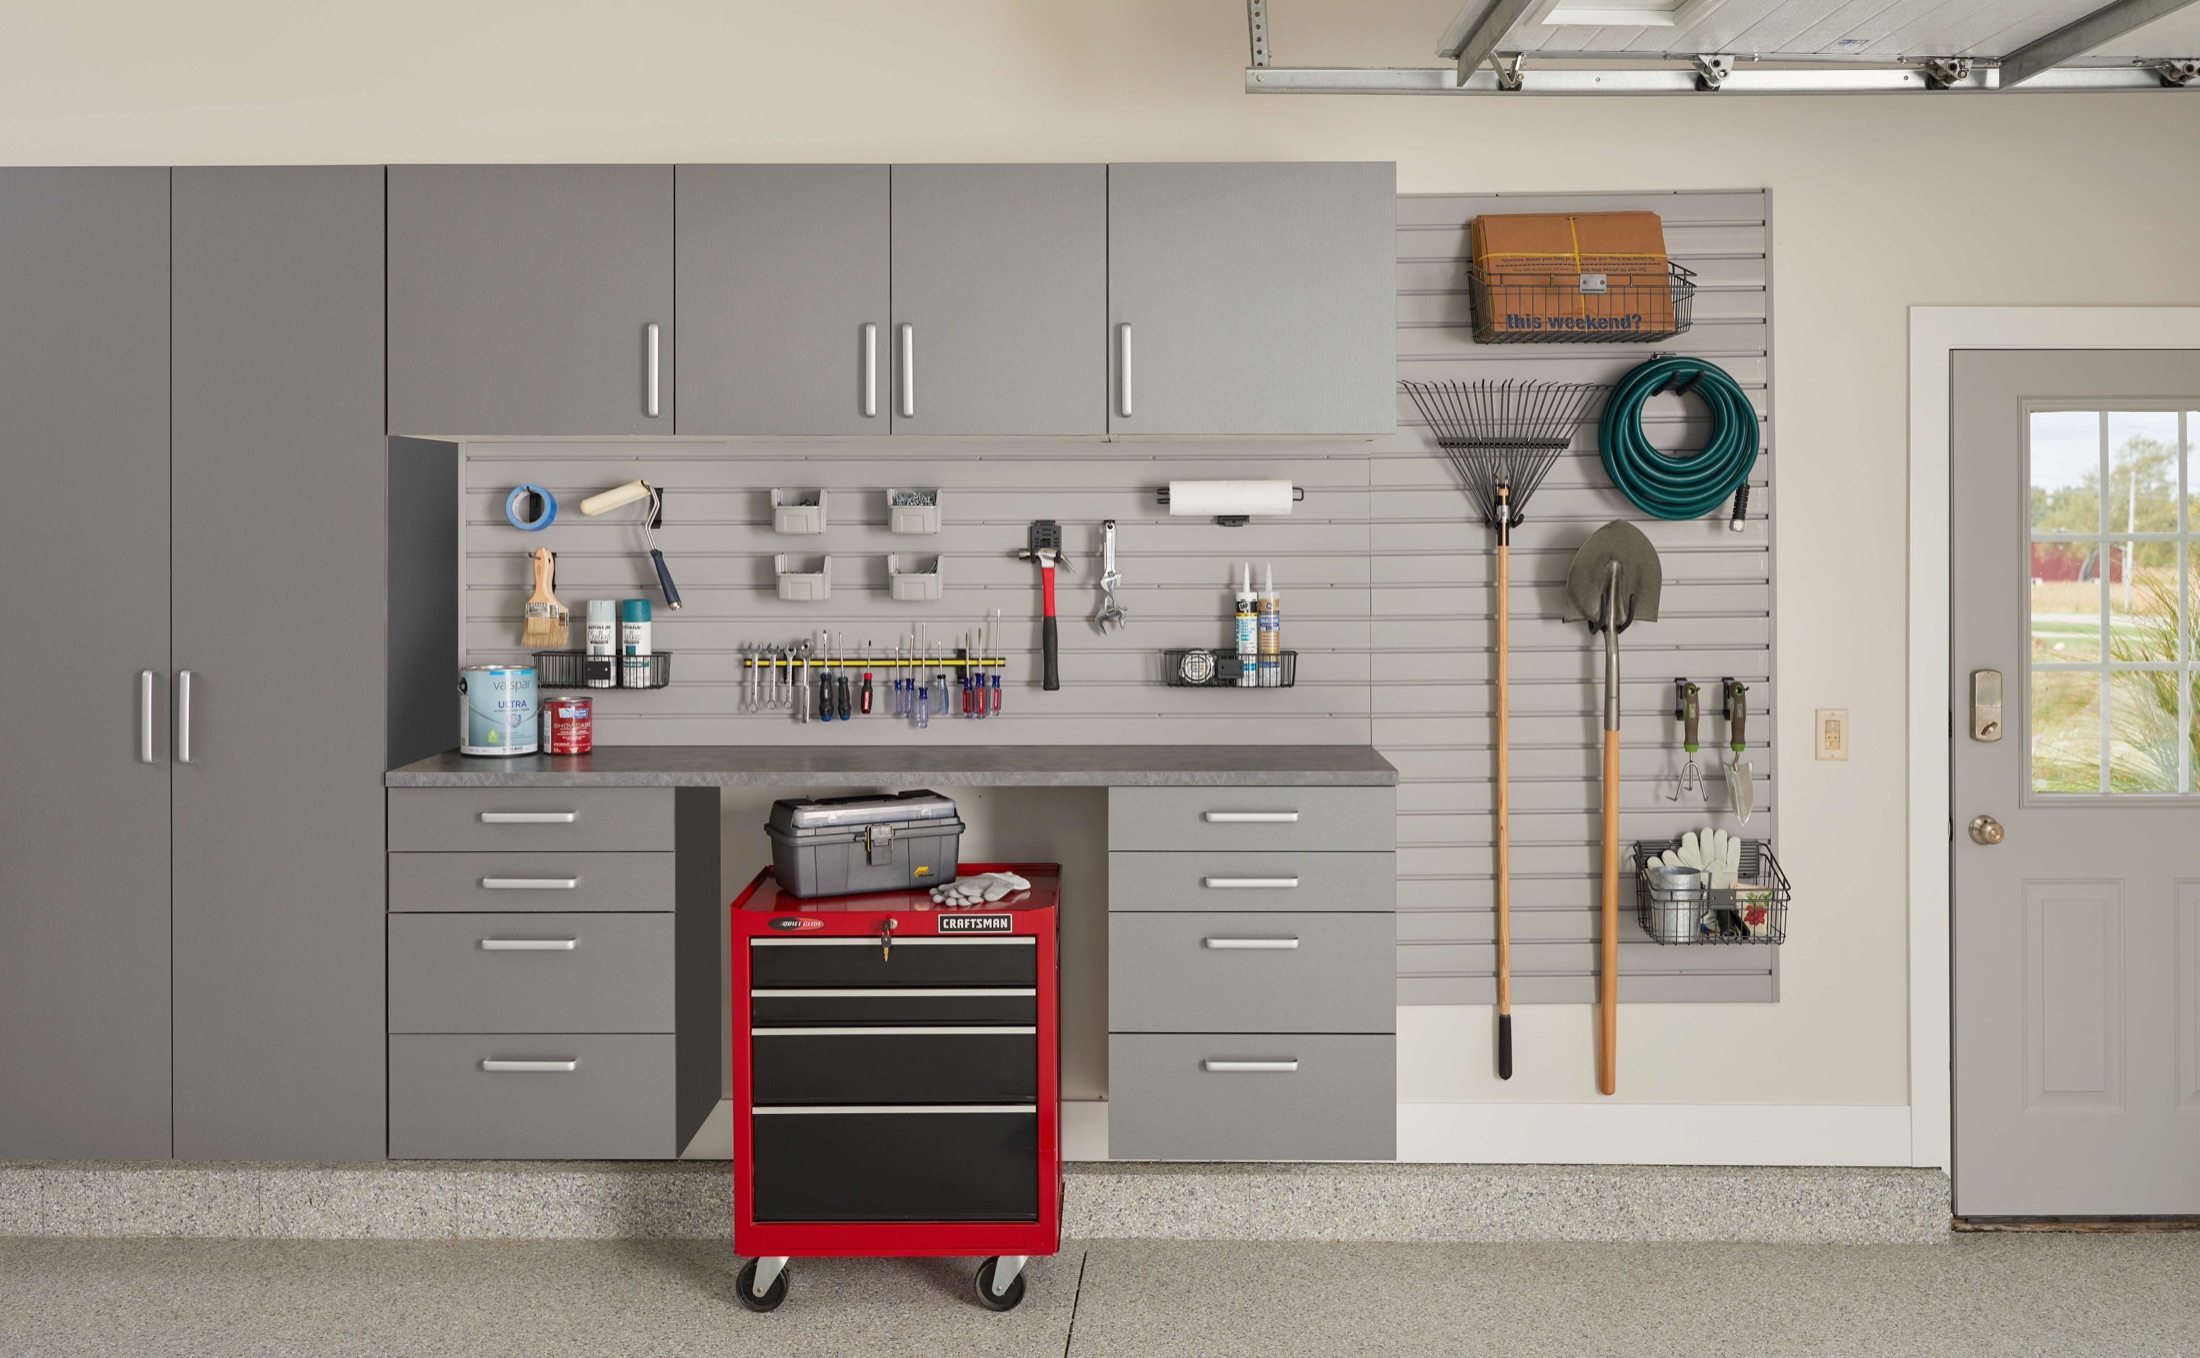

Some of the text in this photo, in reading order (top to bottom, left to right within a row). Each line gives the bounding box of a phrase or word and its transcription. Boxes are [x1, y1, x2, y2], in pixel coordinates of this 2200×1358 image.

[1506, 313, 1642, 330] this weekend?
[493, 680, 532, 692] vaspar
[943, 918, 1008, 929] CRAFTSMAN
